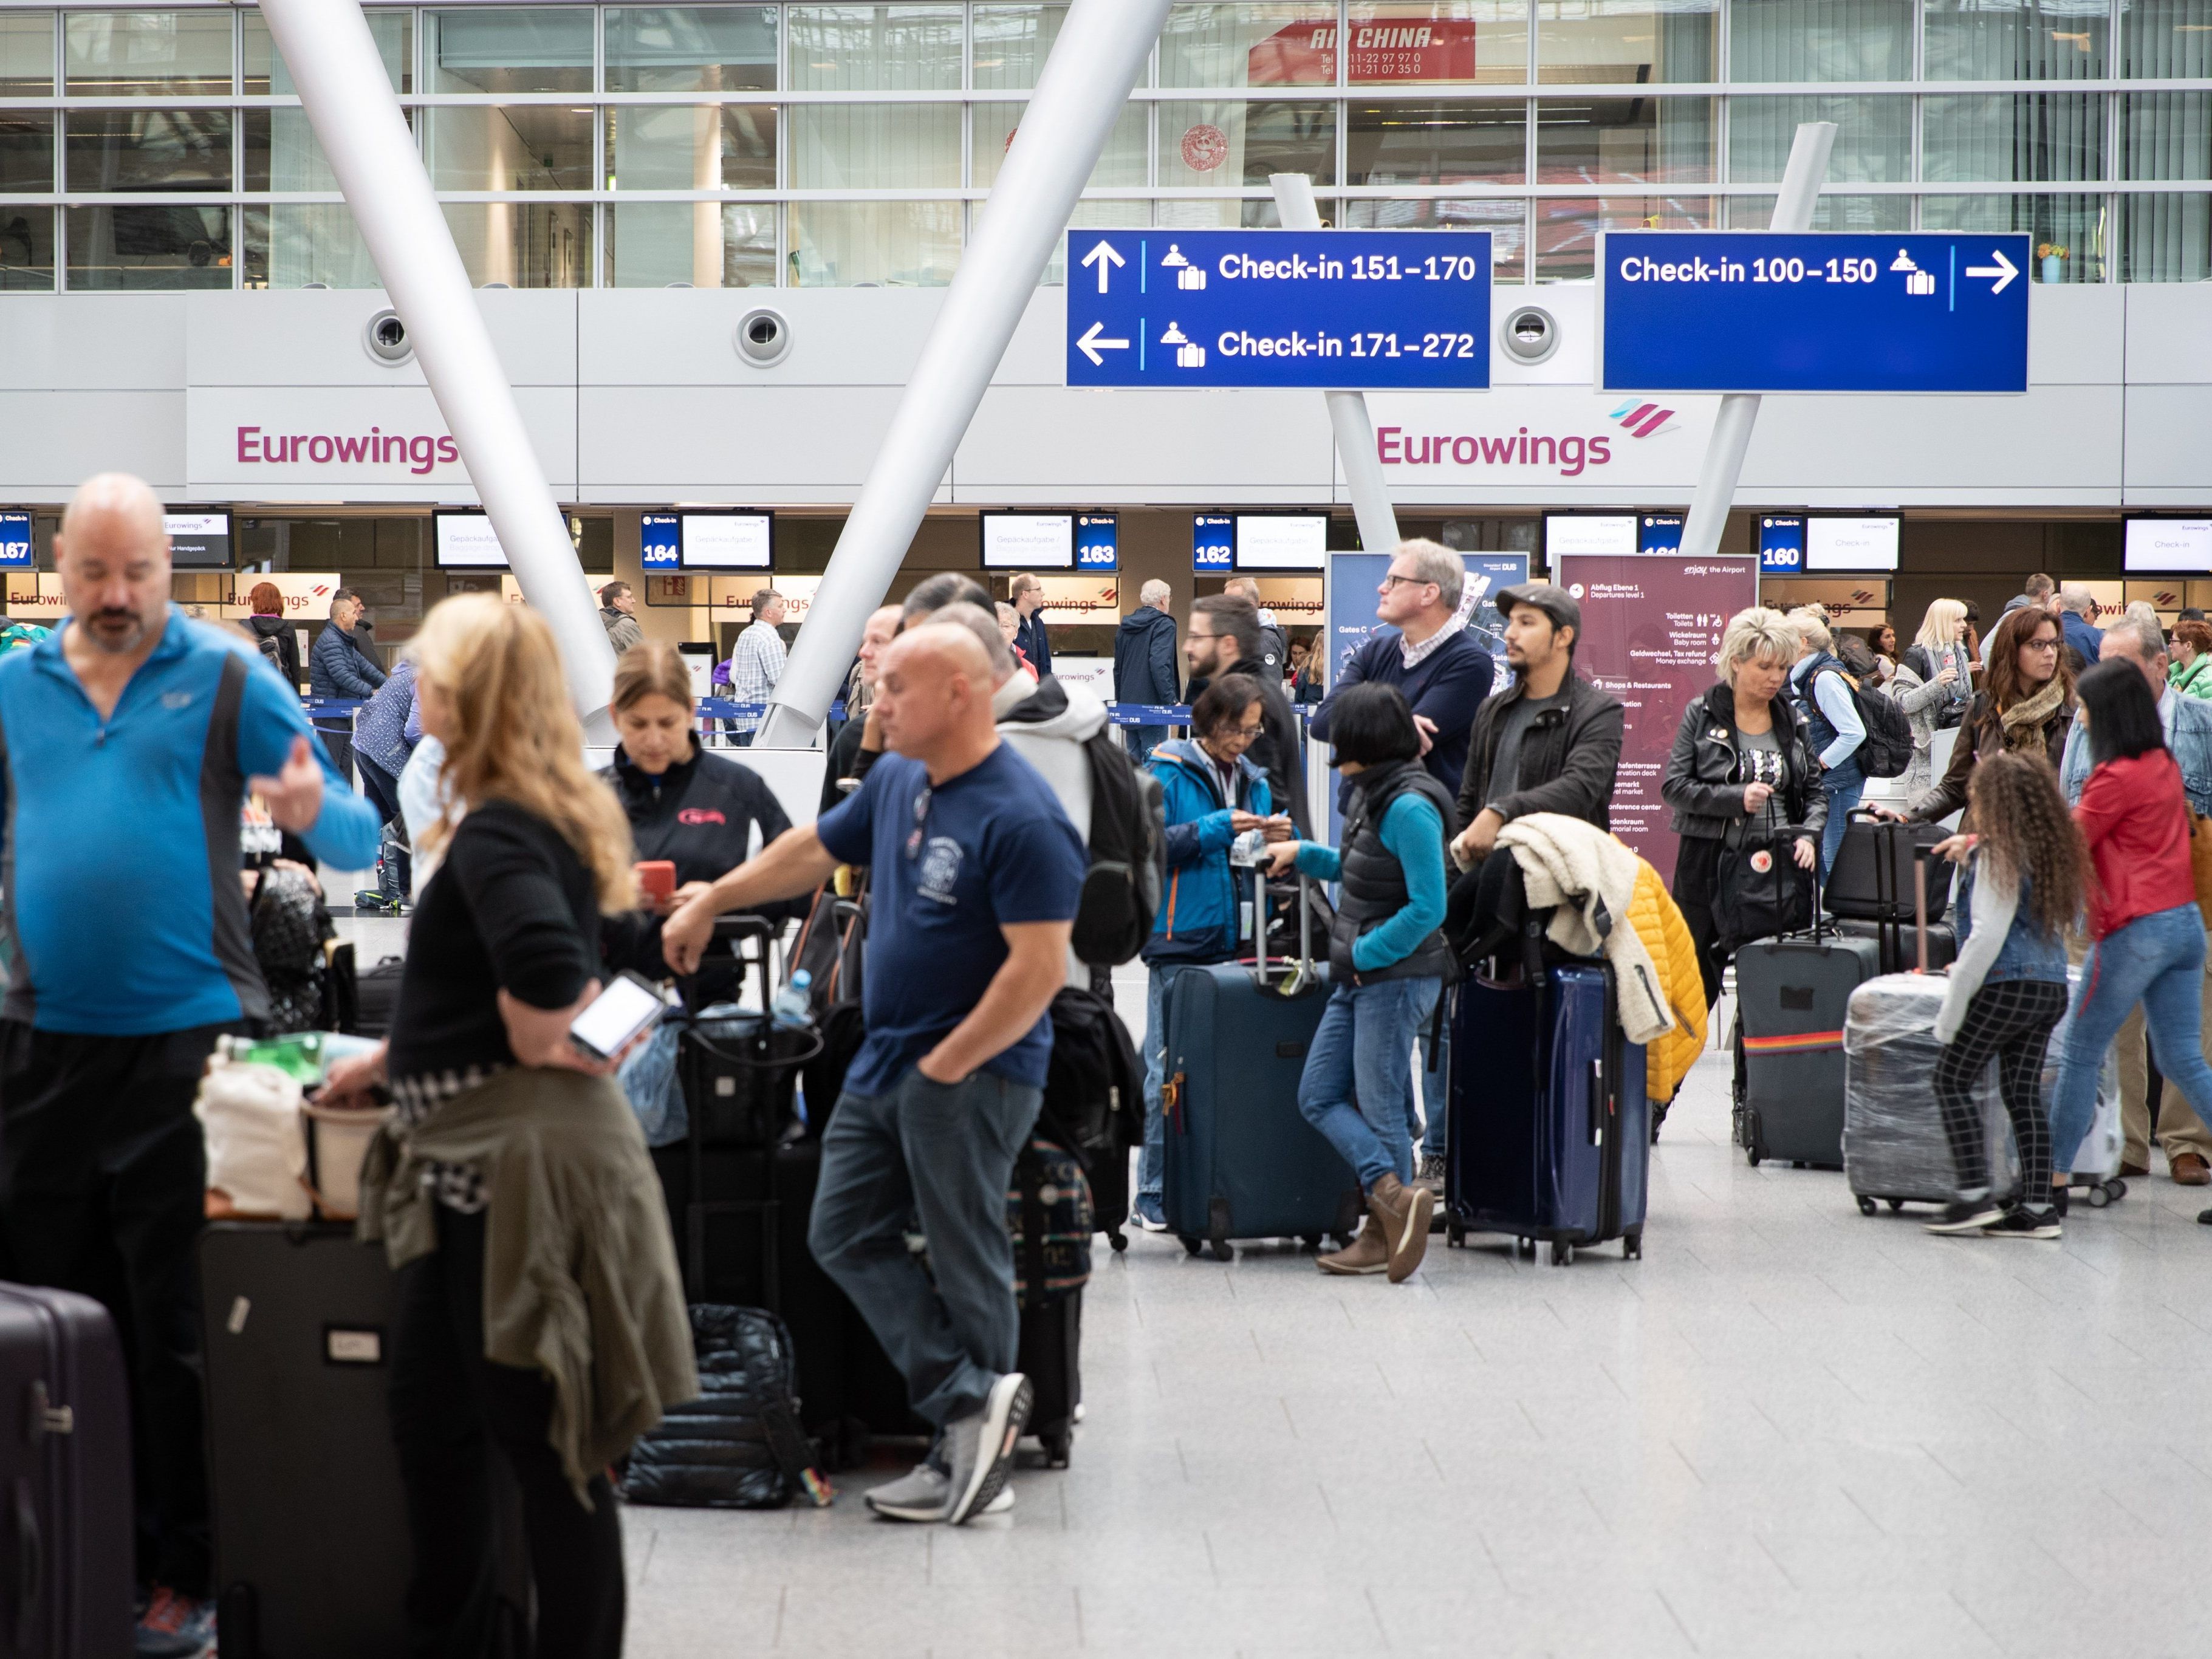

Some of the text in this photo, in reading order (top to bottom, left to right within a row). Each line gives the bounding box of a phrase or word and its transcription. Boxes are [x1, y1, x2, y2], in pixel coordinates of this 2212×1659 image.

[1310, 27, 1431, 49] AI CHINA
[1321, 53, 1420, 63] Tel 11-22 97 97 0
[1321, 64, 1420, 74] Tel 11-21 07 35 0
[1219, 254, 1343, 281] Check-in
[1620, 256, 1744, 282] Check-in
[1217, 332, 1342, 358] Check-in
[238, 426, 459, 474] Eurowings
[1377, 426, 1611, 476] Eurowings
[165, 522, 202, 530] Eurowings
[0, 542, 29, 559] 167
[644, 545, 678, 562] 164
[1080, 546, 1115, 563] 163
[1196, 546, 1231, 563] 162
[1763, 548, 1799, 565] 160
[1683, 565, 1708, 576] enjoy
[1041, 597, 1098, 614] owings
[1260, 598, 1324, 615] rowings
[1056, 672, 1094, 682] urowings
